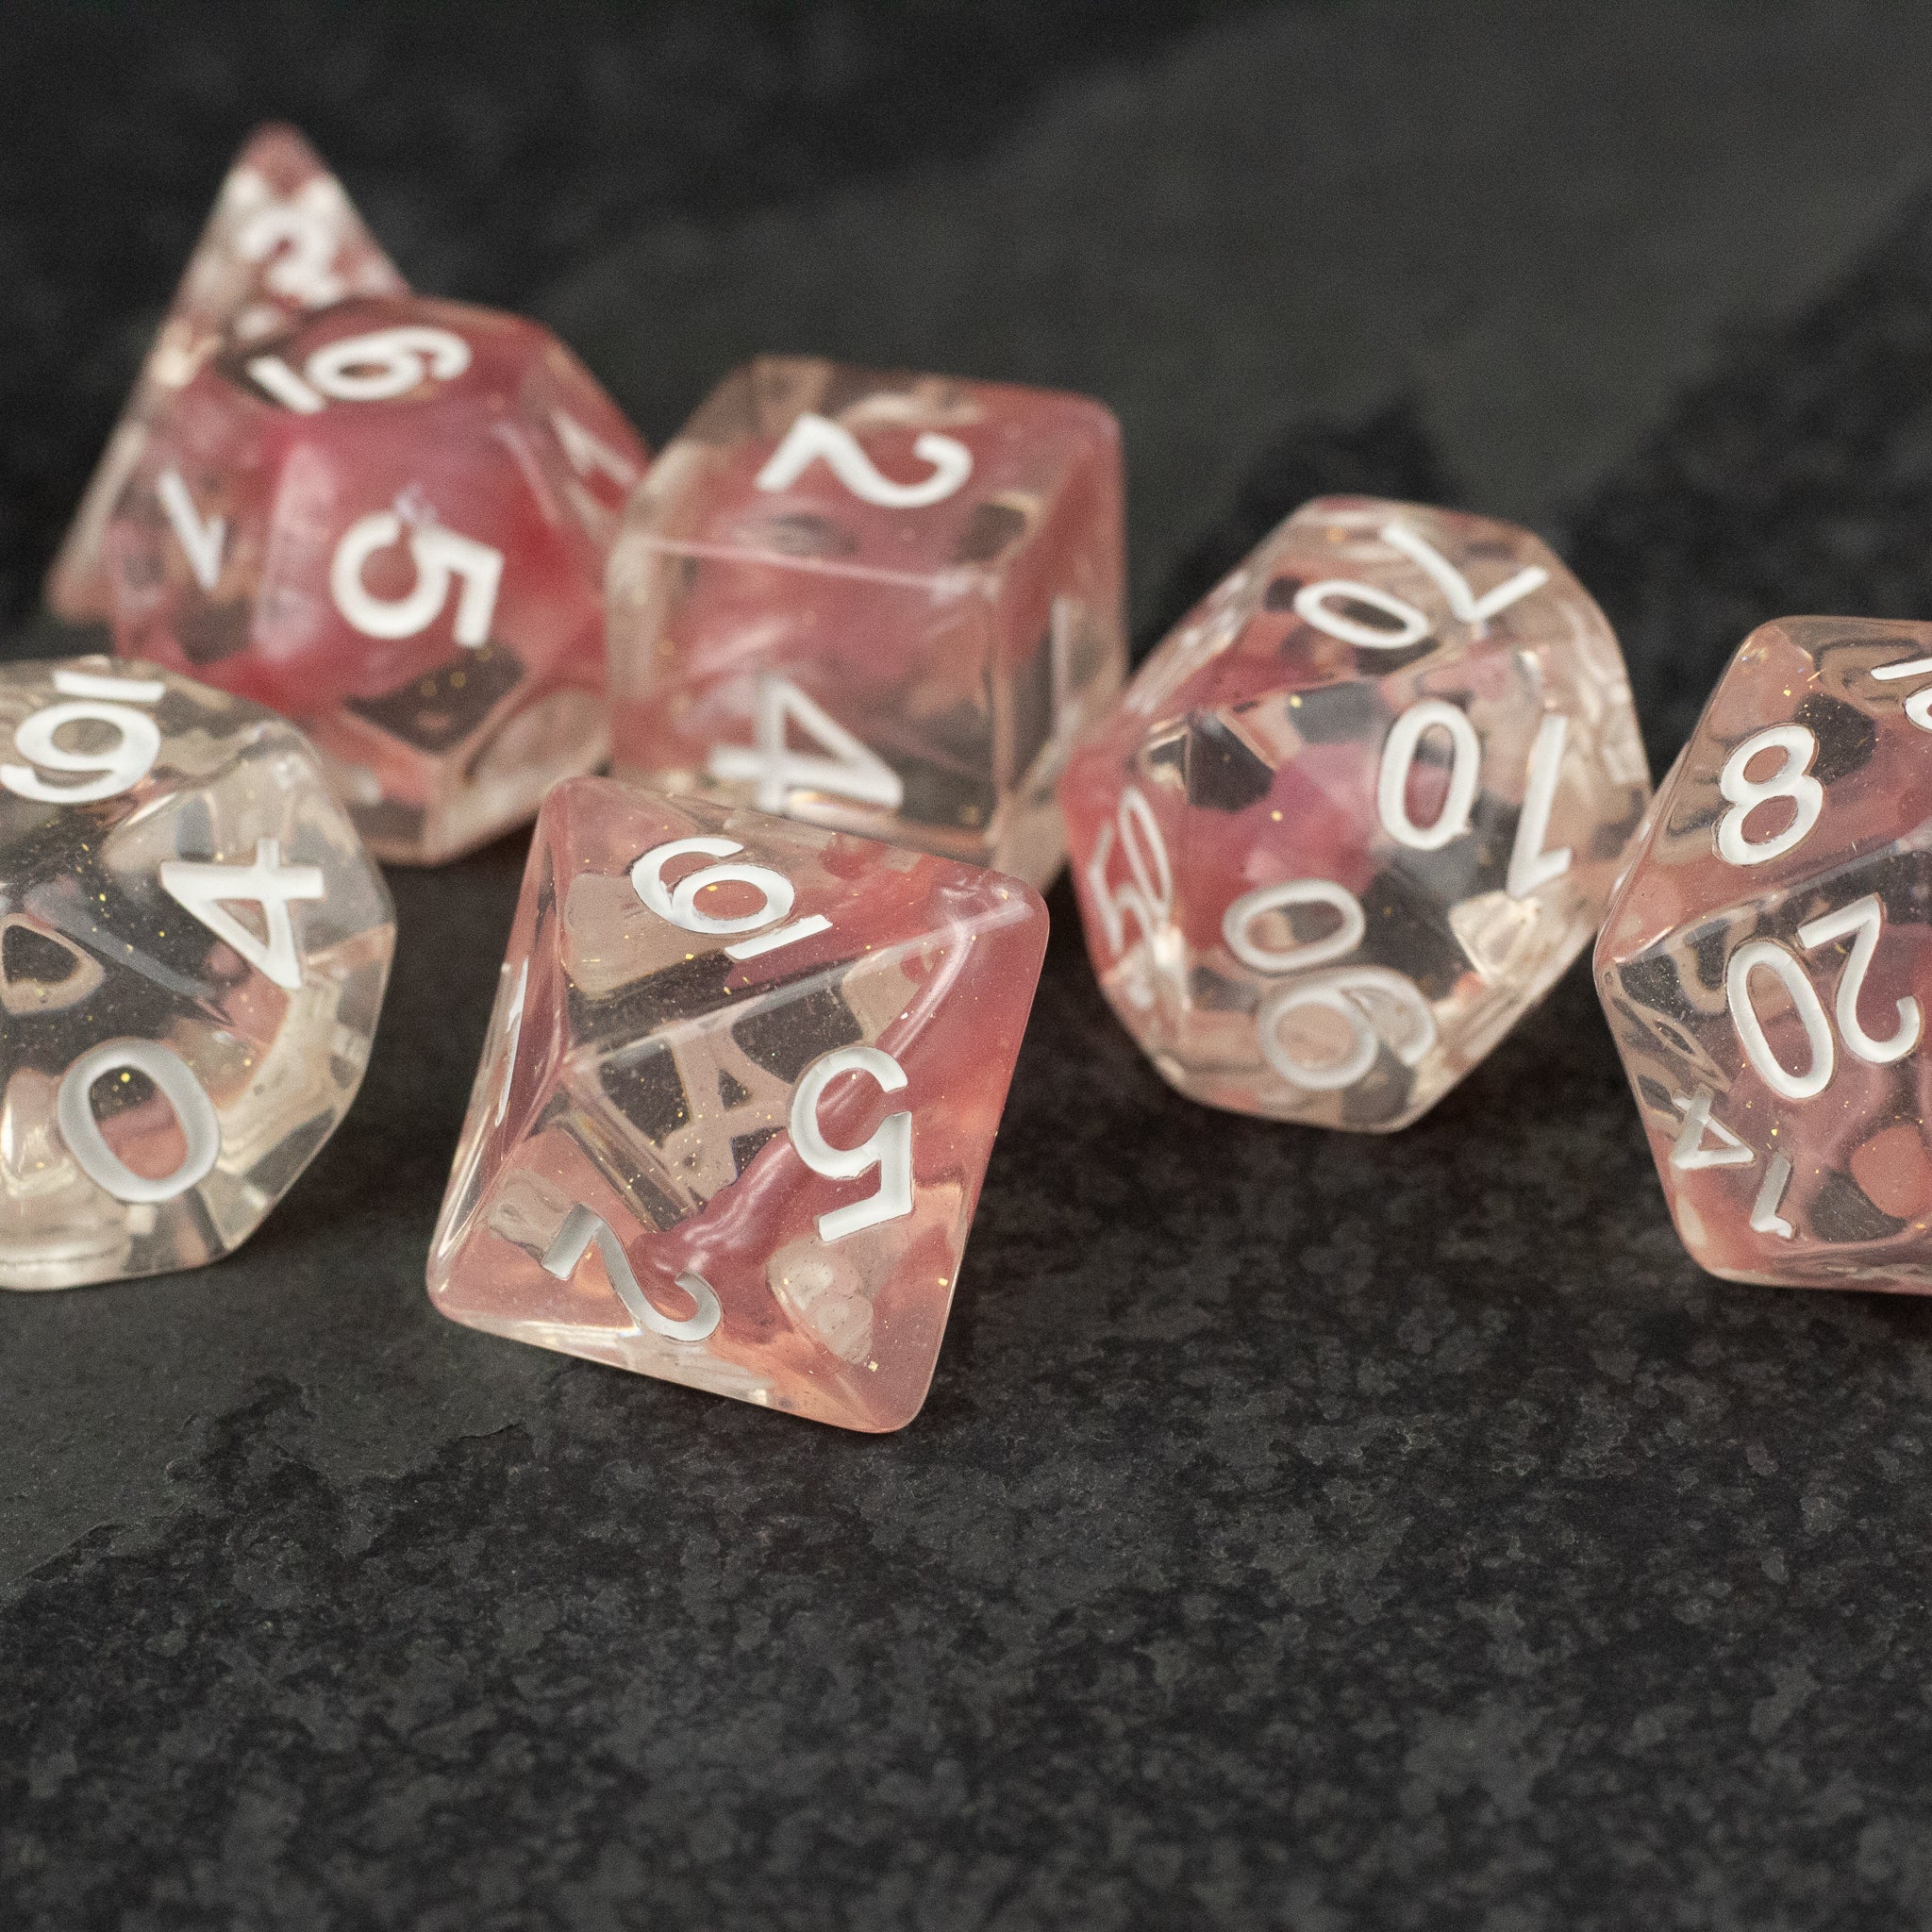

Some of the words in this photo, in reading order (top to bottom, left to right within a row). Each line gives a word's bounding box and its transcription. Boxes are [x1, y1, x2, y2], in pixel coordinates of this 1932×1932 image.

[757, 412, 974, 508] 2
[330, 509, 503, 648] 5
[1292, 524, 1550, 649] 70
[708, 675, 903, 813] 4
[1376, 700, 1572, 898] 10
[1718, 724, 1824, 865] 8
[159, 838, 325, 989] 4
[1726, 893, 1921, 1099] 20
[58, 1039, 221, 1203] 0
[789, 1046, 913, 1241] 5
[541, 1203, 722, 1342] 2
